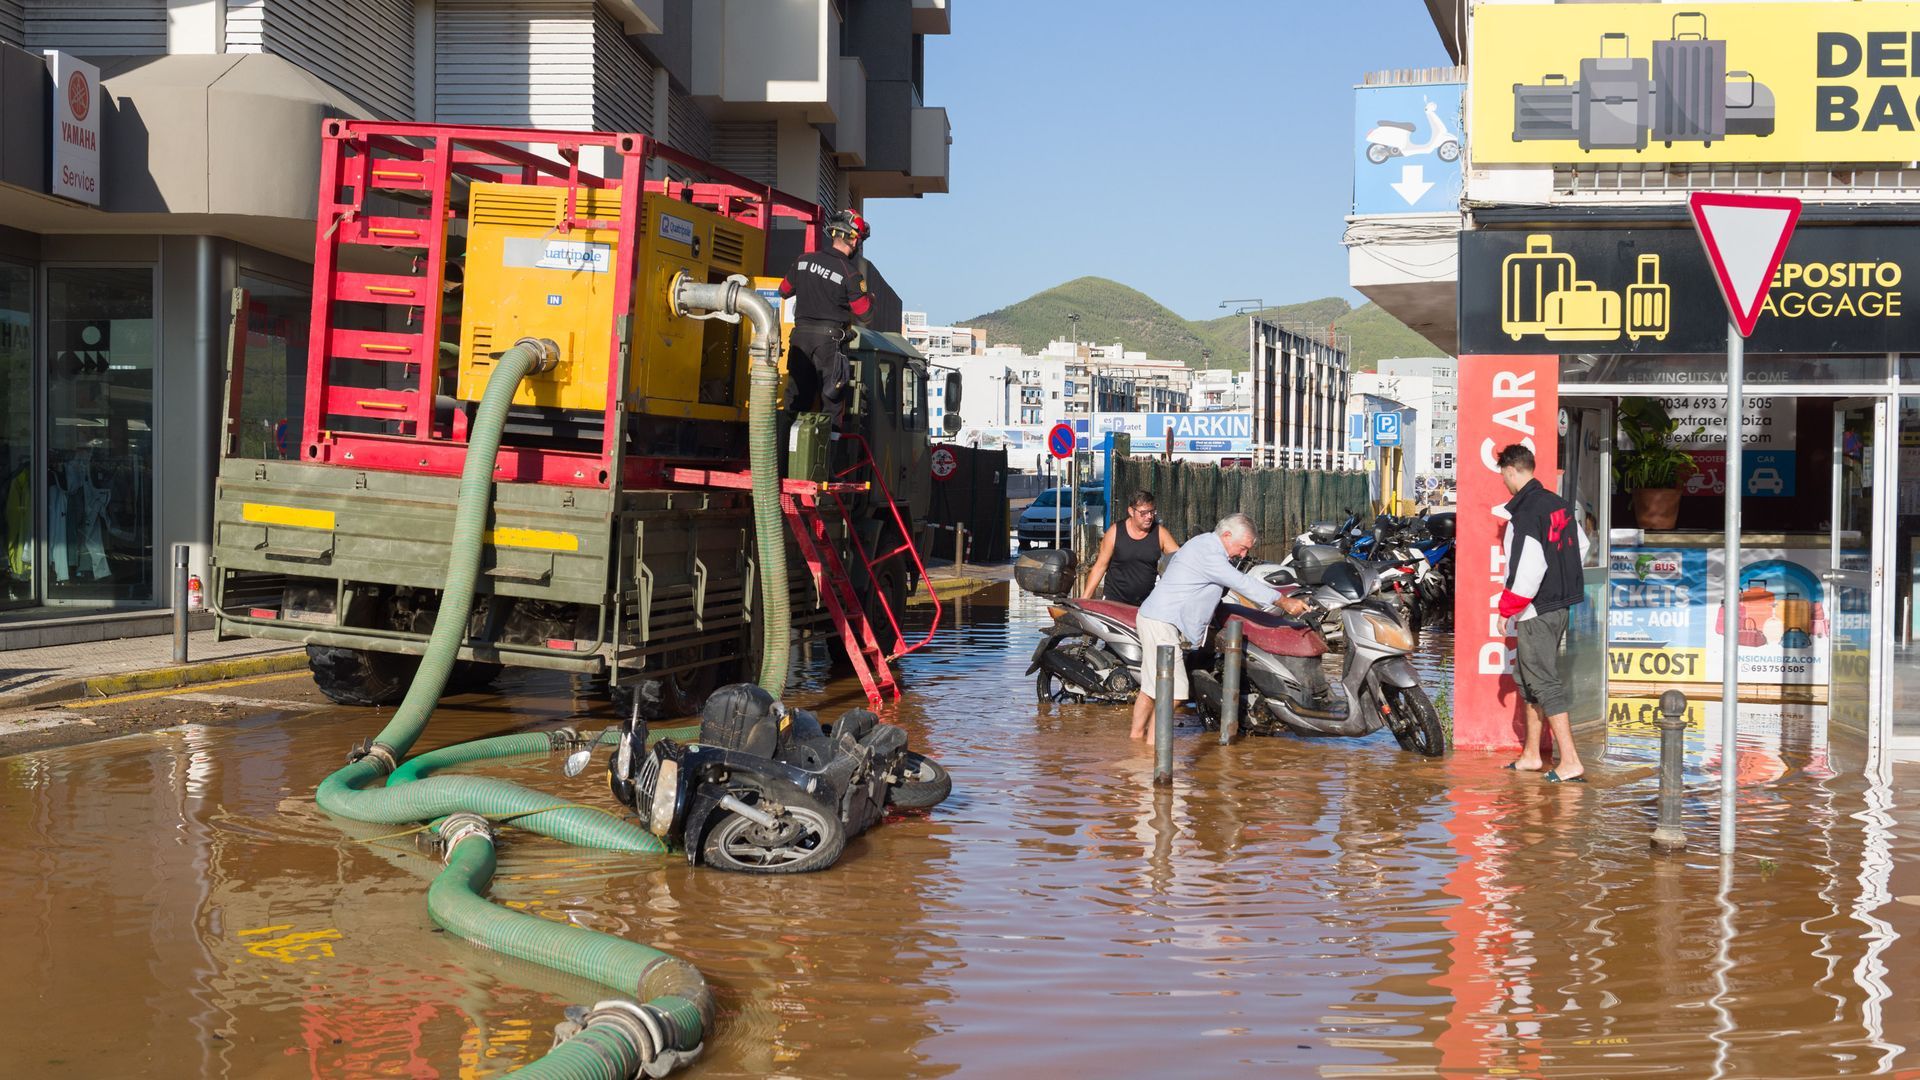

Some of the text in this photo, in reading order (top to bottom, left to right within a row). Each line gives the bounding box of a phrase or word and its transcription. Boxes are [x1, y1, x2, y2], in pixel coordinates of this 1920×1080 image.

[1816, 31, 1920, 78] DE
[1815, 84, 1920, 133] BA
[61, 120, 96, 152] YAMAHA
[62, 165, 95, 193] Service
[545, 248, 602, 264] uatripole
[1768, 262, 1902, 288] EPOSITO
[549, 296, 560, 304] IN
[1758, 292, 1902, 318] AGGAGE
[1719, 371, 1789, 384] WCOME
[1693, 397, 1717, 409] 693
[1748, 397, 1772, 409] 505
[1162, 415, 1249, 437] PARKIN
[1381, 416, 1393, 431] P
[1692, 455, 1725, 463] COOTER
[1757, 456, 1775, 464] CAR
[1654, 563, 1676, 571] BUS
[1639, 652, 1699, 676] COST
[1738, 655, 1822, 665] NSIGNAIBIZA.COM
[1769, 665, 1786, 673] 750
